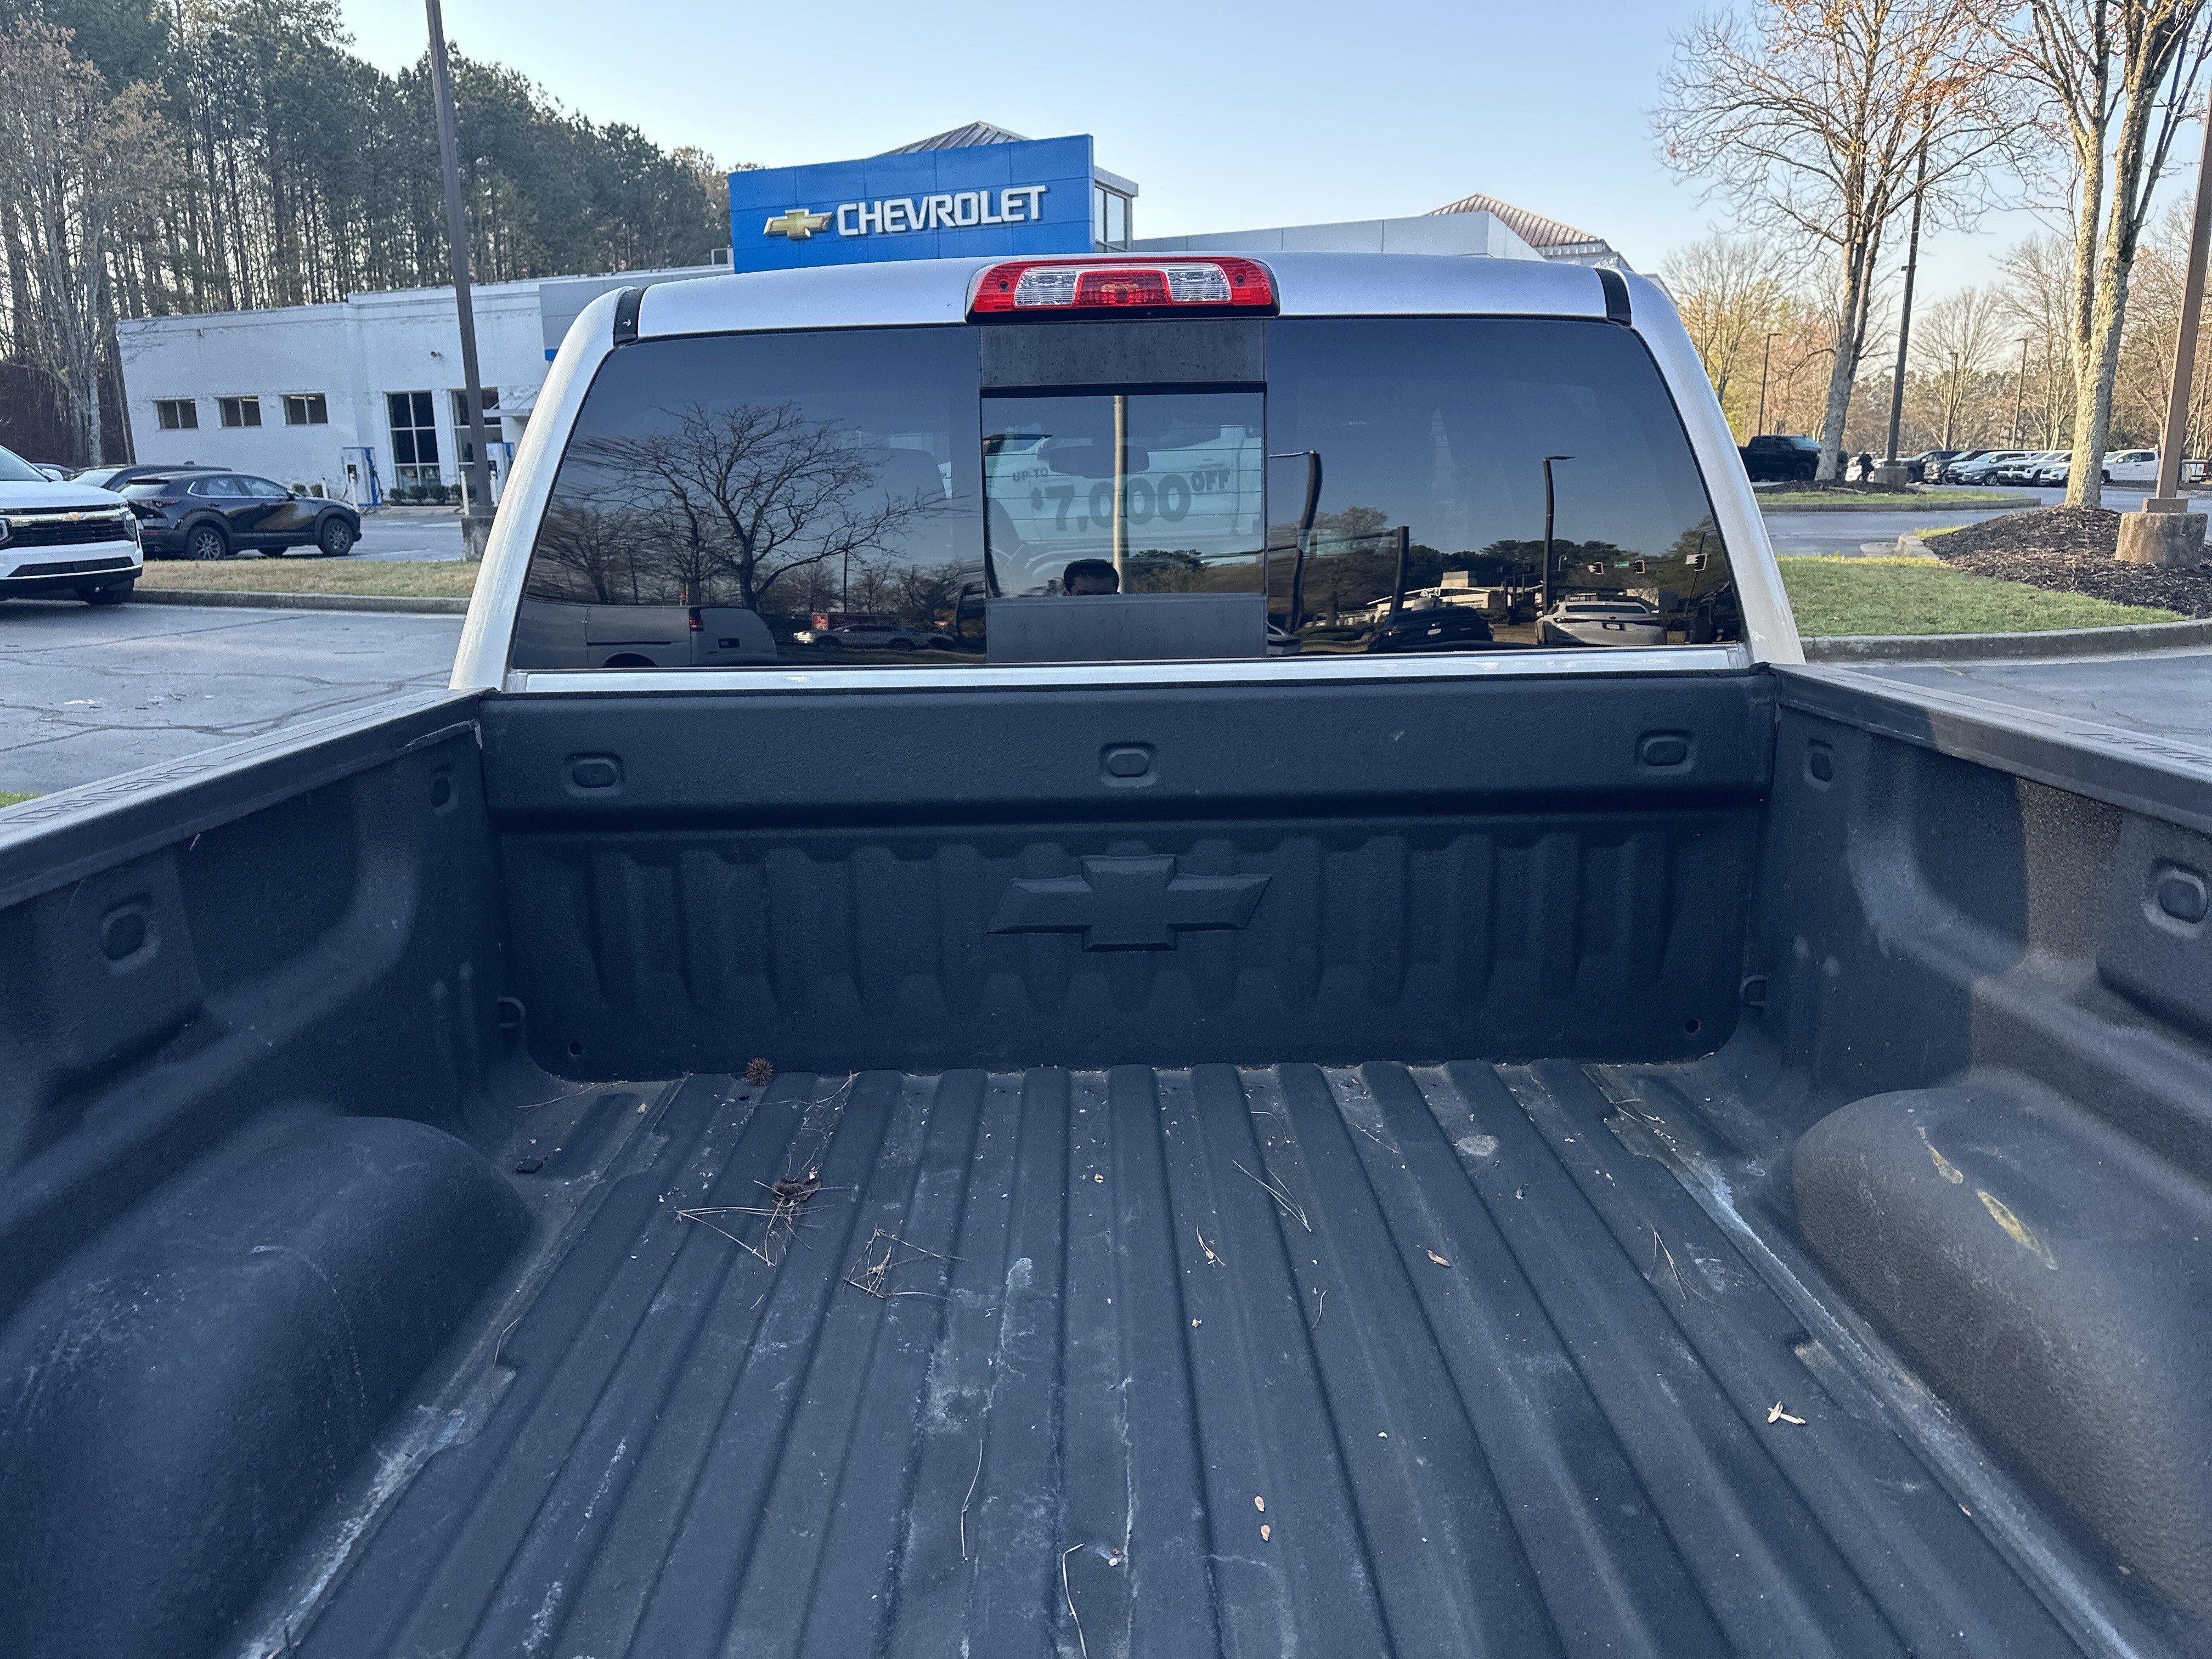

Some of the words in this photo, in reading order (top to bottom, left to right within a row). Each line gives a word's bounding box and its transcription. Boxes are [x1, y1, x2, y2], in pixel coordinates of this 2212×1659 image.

[837, 185, 1047, 236] CHEVROLET
[1012, 470, 1029, 482] UP
[1032, 466, 1048, 479] TO
[1190, 467, 1231, 492] OFF
